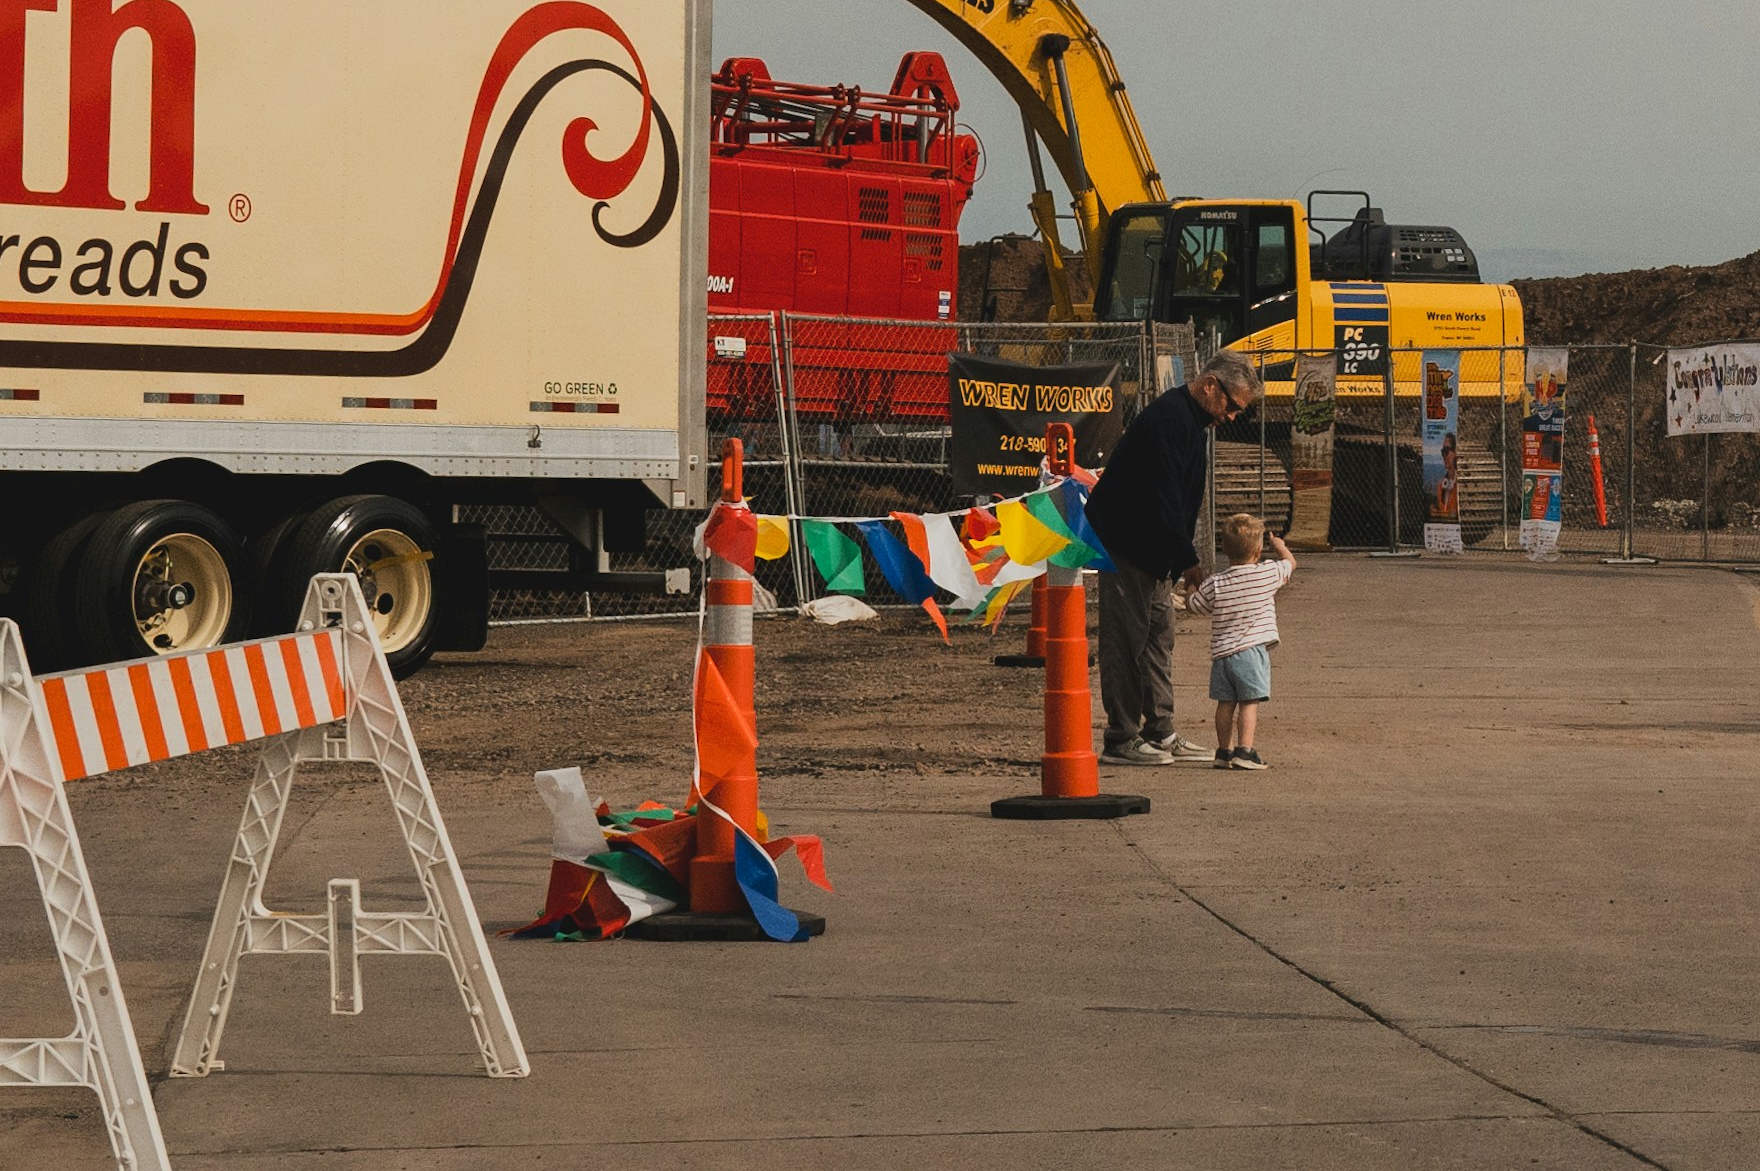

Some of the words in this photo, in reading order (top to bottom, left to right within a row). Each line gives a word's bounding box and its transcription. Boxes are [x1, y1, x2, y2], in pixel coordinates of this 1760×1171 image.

[1201, 211, 1237, 219] KOMATSU
[1426, 311, 1452, 321] Wren
[1455, 312, 1486, 322] Works
[1343, 327, 1364, 341] PC
[1344, 362, 1359, 374] LC
[544, 382, 561, 394] GO
[565, 382, 604, 395] GREEN
[959, 379, 1030, 410] WREN
[1036, 385, 1113, 412] WORKS
[977, 463, 1041, 477] www.wrenw
